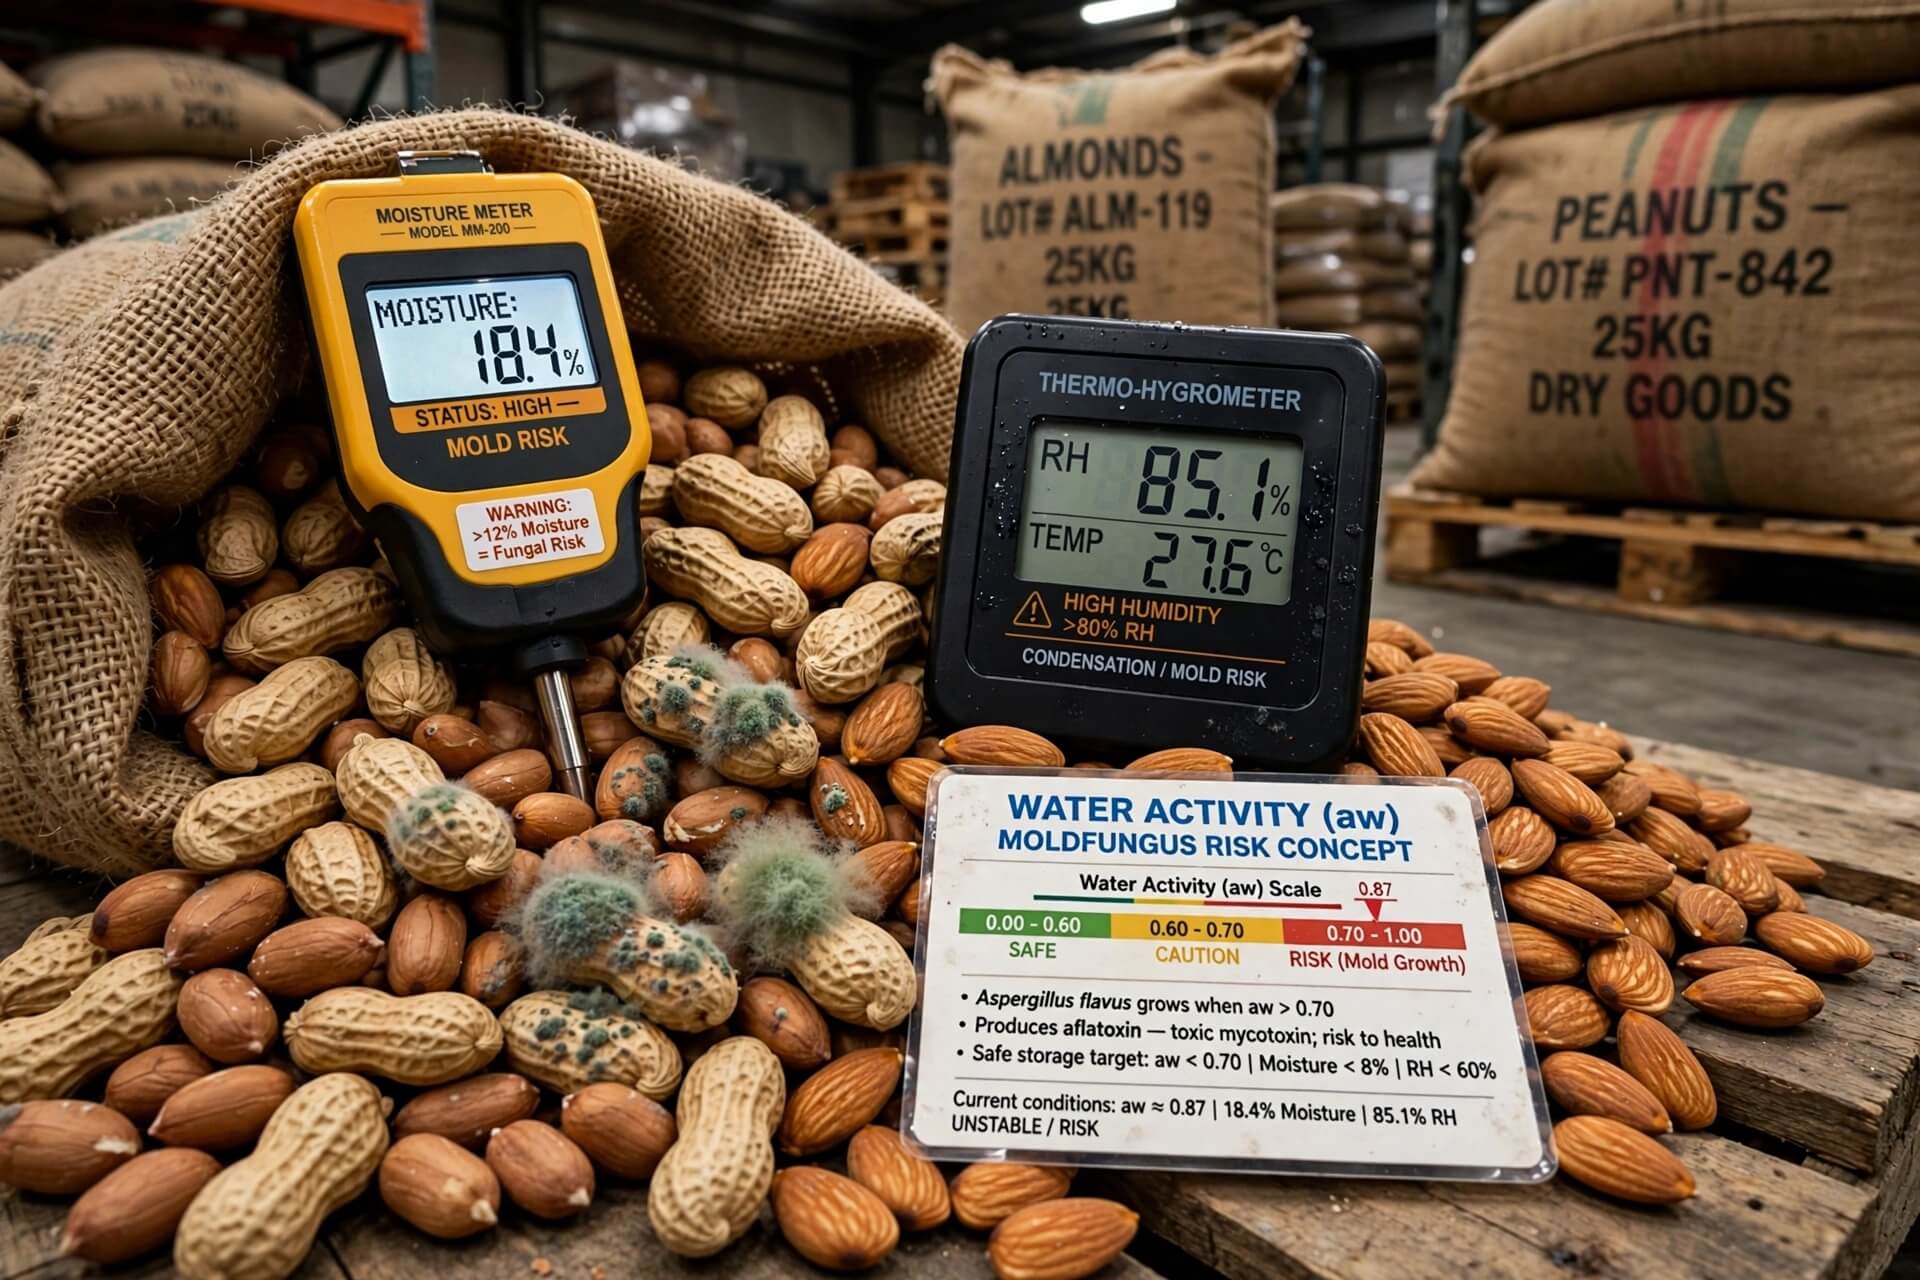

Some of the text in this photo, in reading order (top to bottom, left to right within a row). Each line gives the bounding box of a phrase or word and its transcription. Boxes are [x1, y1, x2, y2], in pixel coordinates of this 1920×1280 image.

[999, 136, 1183, 187] ALMONDS
[376, 203, 533, 224] MOISTURE METER
[981, 188, 1212, 241] LOT# ALM-119
[1551, 180, 1789, 243] PEANUTS
[409, 223, 511, 239] MODEL MM-200
[1044, 243, 1136, 287] 25KG
[1514, 247, 1834, 303] LOT# PNT-842
[374, 291, 517, 328] MOISTURE:
[1593, 311, 1713, 360] 25KG
[1039, 371, 1301, 412] THERMO-HYGROMETER
[1528, 371, 1792, 422] DRY GOODS
[415, 403, 498, 427] STATUS:
[503, 397, 552, 417] HIGH
[446, 426, 570, 459] MOLD RISK
[1040, 439, 1090, 474] RH
[486, 498, 572, 522] WARNING:
[472, 516, 589, 543] >12% Moisture
[1030, 522, 1103, 554] TEMP
[493, 537, 547, 561] Fungal
[552, 534, 586, 550] Risk
[1064, 592, 1223, 625] HIGH HUMIDITY
[1063, 617, 1155, 642] >80% RH
[1022, 648, 1156, 678] CONDENSATION
[1171, 663, 1222, 684] MOLD
[1226, 669, 1268, 689] RISK
[1008, 794, 1399, 835] WATER ACTIVITY (aw)
[998, 829, 1413, 862] MOLDFUNGUS RISK CONCEPT
[1080, 874, 1322, 900] Water Activity (aw) Scale
[1359, 882, 1392, 897] 0.87
[986, 914, 1024, 931] 0.00
[1043, 917, 1081, 933] 0.60
[1150, 920, 1188, 936] 0.60
[1206, 921, 1244, 938] 0.70
[1326, 925, 1364, 942] 0.70
[1384, 927, 1422, 944] 1.00
[1009, 942, 1057, 959] SAFE
[1155, 946, 1240, 964] CAUTION
[1290, 951, 1466, 976] RISK (Mold Growth)
[975, 989, 1334, 1017] Aspergillus flavus grows when aw > 0.70
[975, 1016, 1058, 1036] Produces
[1063, 1019, 1141, 1038] aflatoxin
[1170, 1024, 1214, 1041] toxic
[1219, 1026, 1317, 1047] mycotoxin;
[1322, 1028, 1355, 1046] risk
[1360, 1030, 1379, 1047] to
[1383, 1030, 1442, 1049] health
[972, 1044, 1012, 1062] Safe
[1017, 1049, 1084, 1068] storage
[1090, 1050, 1149, 1071] target:
[1155, 1054, 1180, 1068] aw
[1186, 1055, 1197, 1067] <
[1203, 1052, 1241, 1070] 0.70
[1259, 1054, 1338, 1074] Moisture
[1344, 1061, 1355, 1073] <
[1361, 1058, 1389, 1076] 8%
[1407, 1060, 1433, 1077] RH
[1439, 1064, 1451, 1077] <
[1457, 1061, 1497, 1080] 60%
[953, 1090, 1018, 1110] Current
[1023, 1094, 1116, 1113] conditions:
[1121, 1100, 1146, 1114] aw
[1151, 1102, 1164, 1113] ≈
[1169, 1098, 1206, 1116] 0.87
[1224, 1100, 1275, 1120] 18.4%
[1281, 1102, 1356, 1122] Moisture
[1373, 1106, 1426, 1126] 85.1%
[1432, 1108, 1458, 1126] RH
[952, 1114, 1042, 1134] UNSTABLE
[1059, 1119, 1100, 1137] RISK
